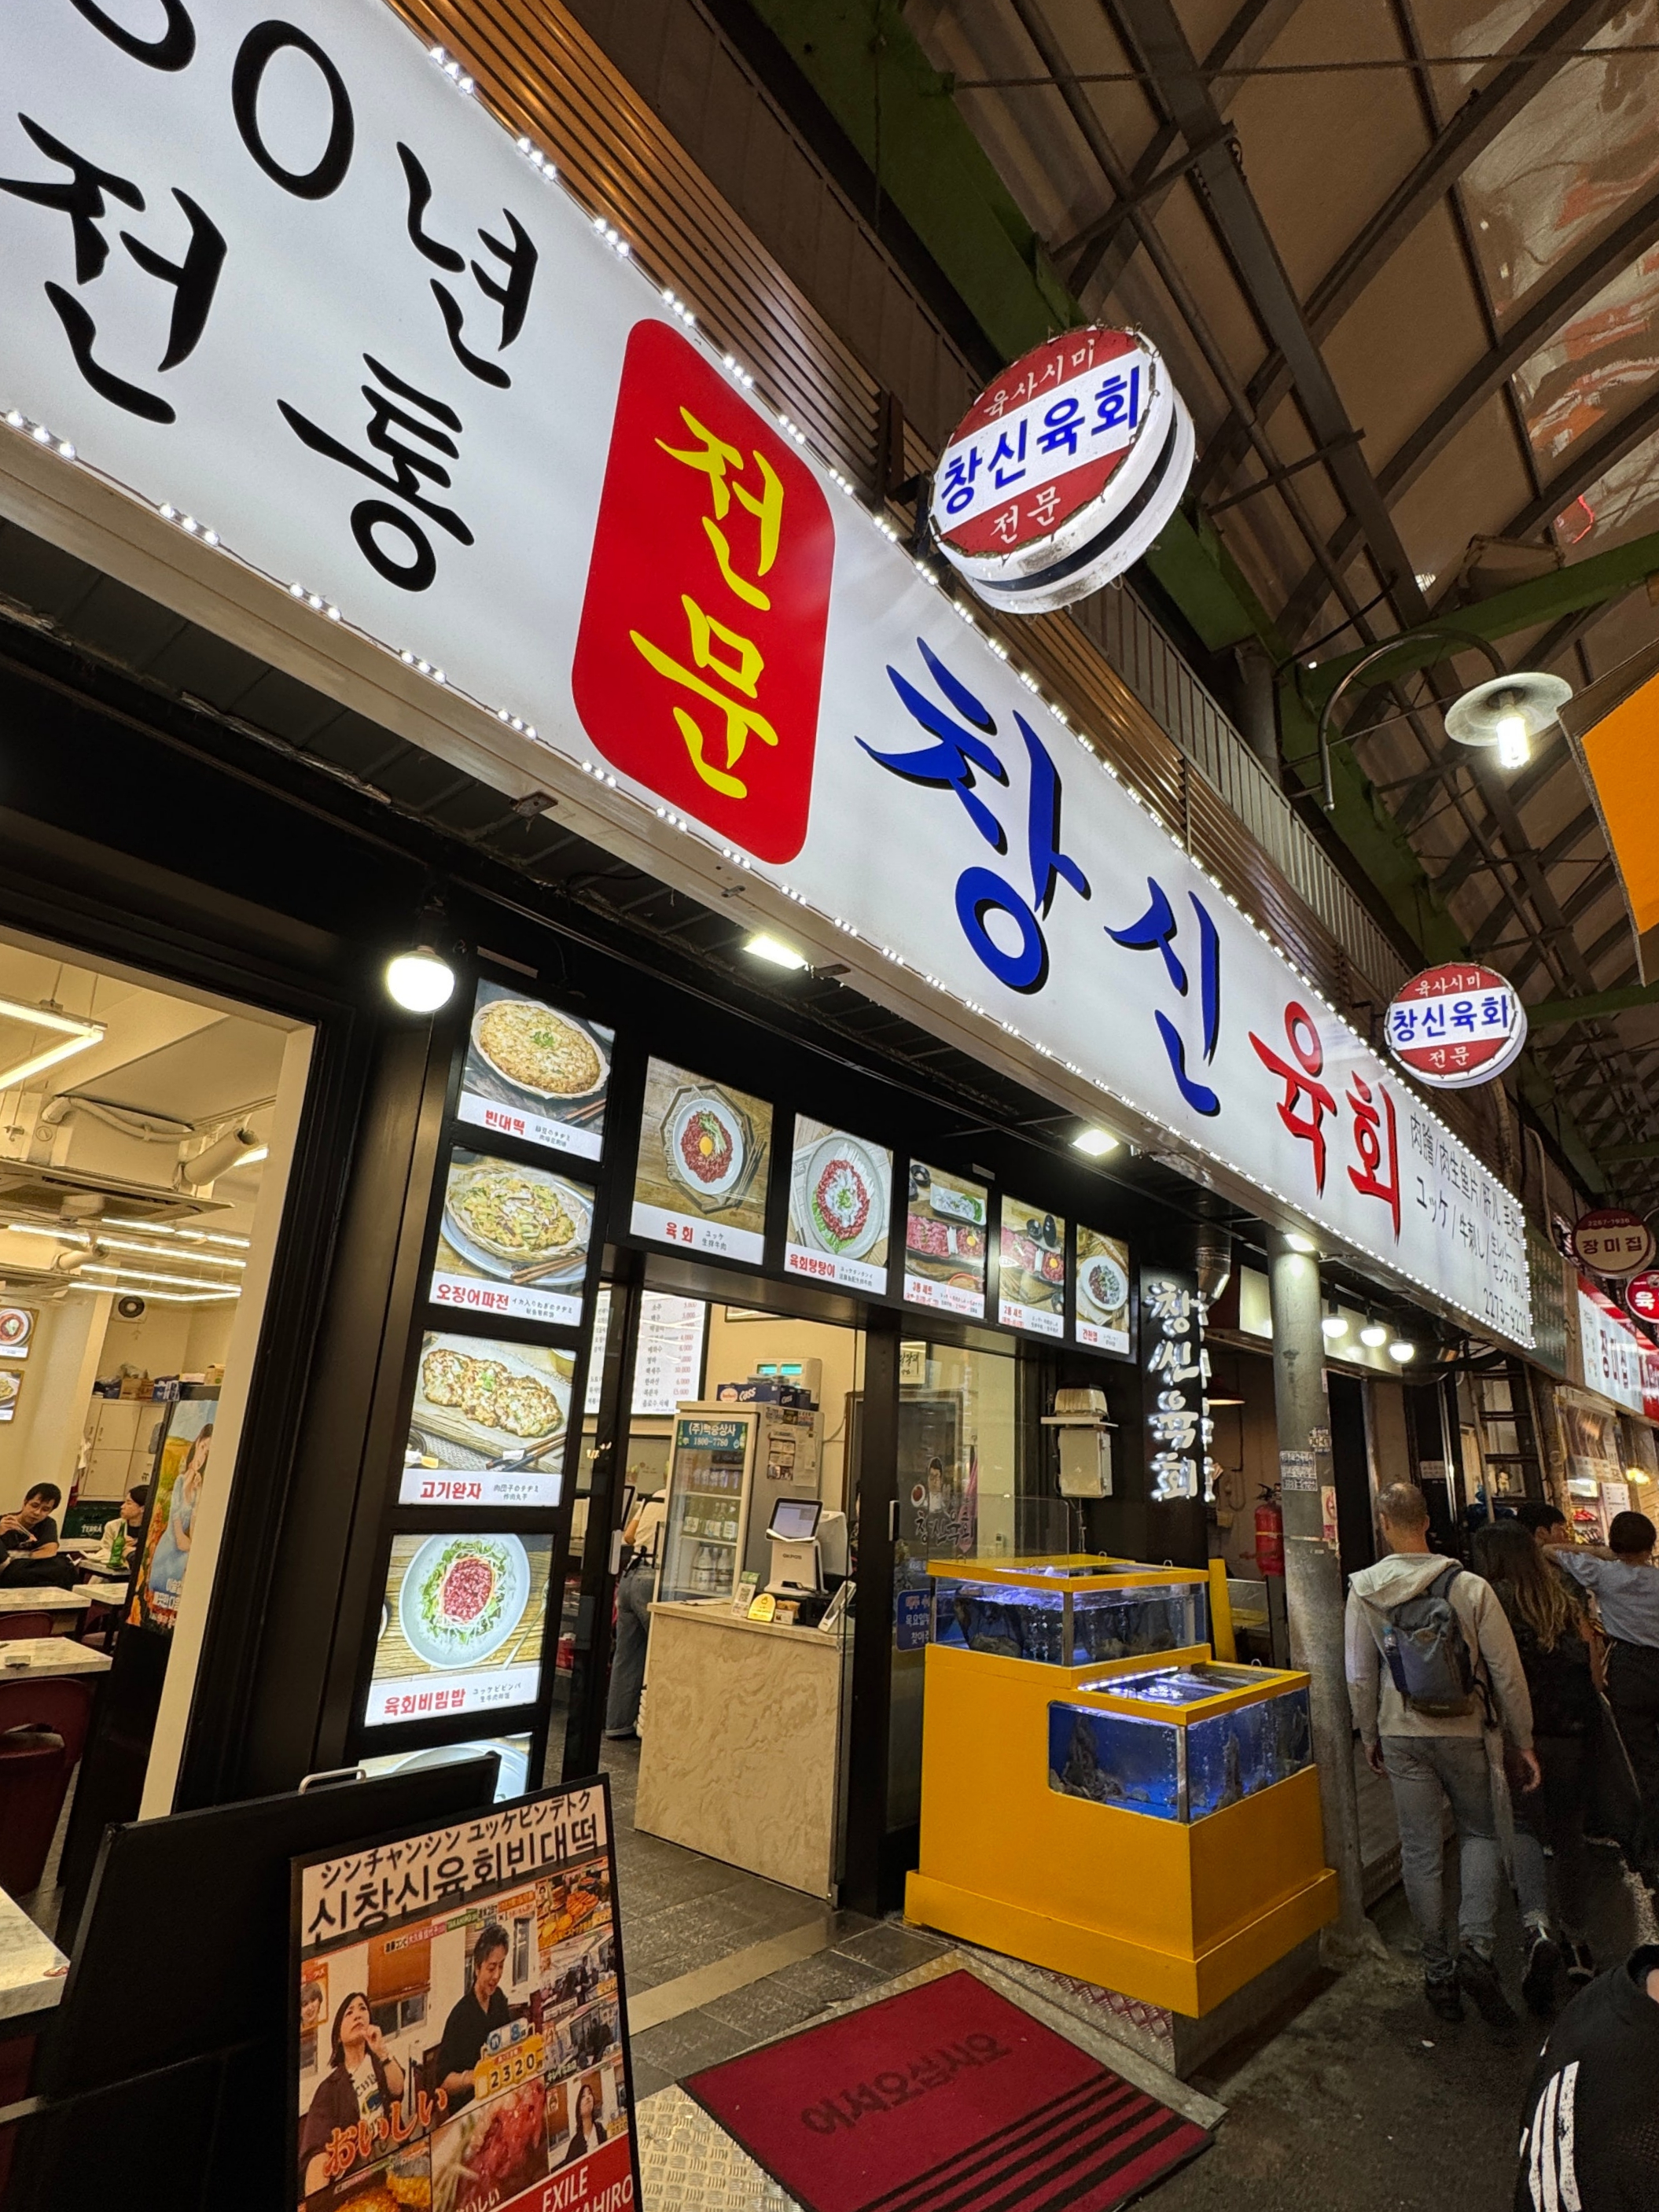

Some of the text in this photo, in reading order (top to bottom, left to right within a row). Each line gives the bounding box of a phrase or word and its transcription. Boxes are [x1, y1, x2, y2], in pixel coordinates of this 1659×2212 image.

[983, 338, 1095, 418] 육사시미
[941, 365, 1140, 515] 창신육회
[990, 486, 1061, 544] 전문
[631, 406, 784, 800] 전문
[1414, 972, 1481, 997] 육사시미
[1392, 994, 1509, 1043] 창신육회
[1428, 1046, 1470, 1069] 전문
[485, 1109, 526, 1136] 빈대떡
[666, 1221, 693, 1244] 육회
[789, 1253, 836, 1279] 육회탕탕이
[436, 1283, 509, 1311] 오징어파전
[1144, 1281, 1201, 1500] 창신육회
[420, 1481, 483, 1500] 고기완자
[384, 1688, 466, 1717] 육회비빔밥
[323, 2088, 448, 2177] おいしい
[542, 2165, 589, 2212] EXILE
